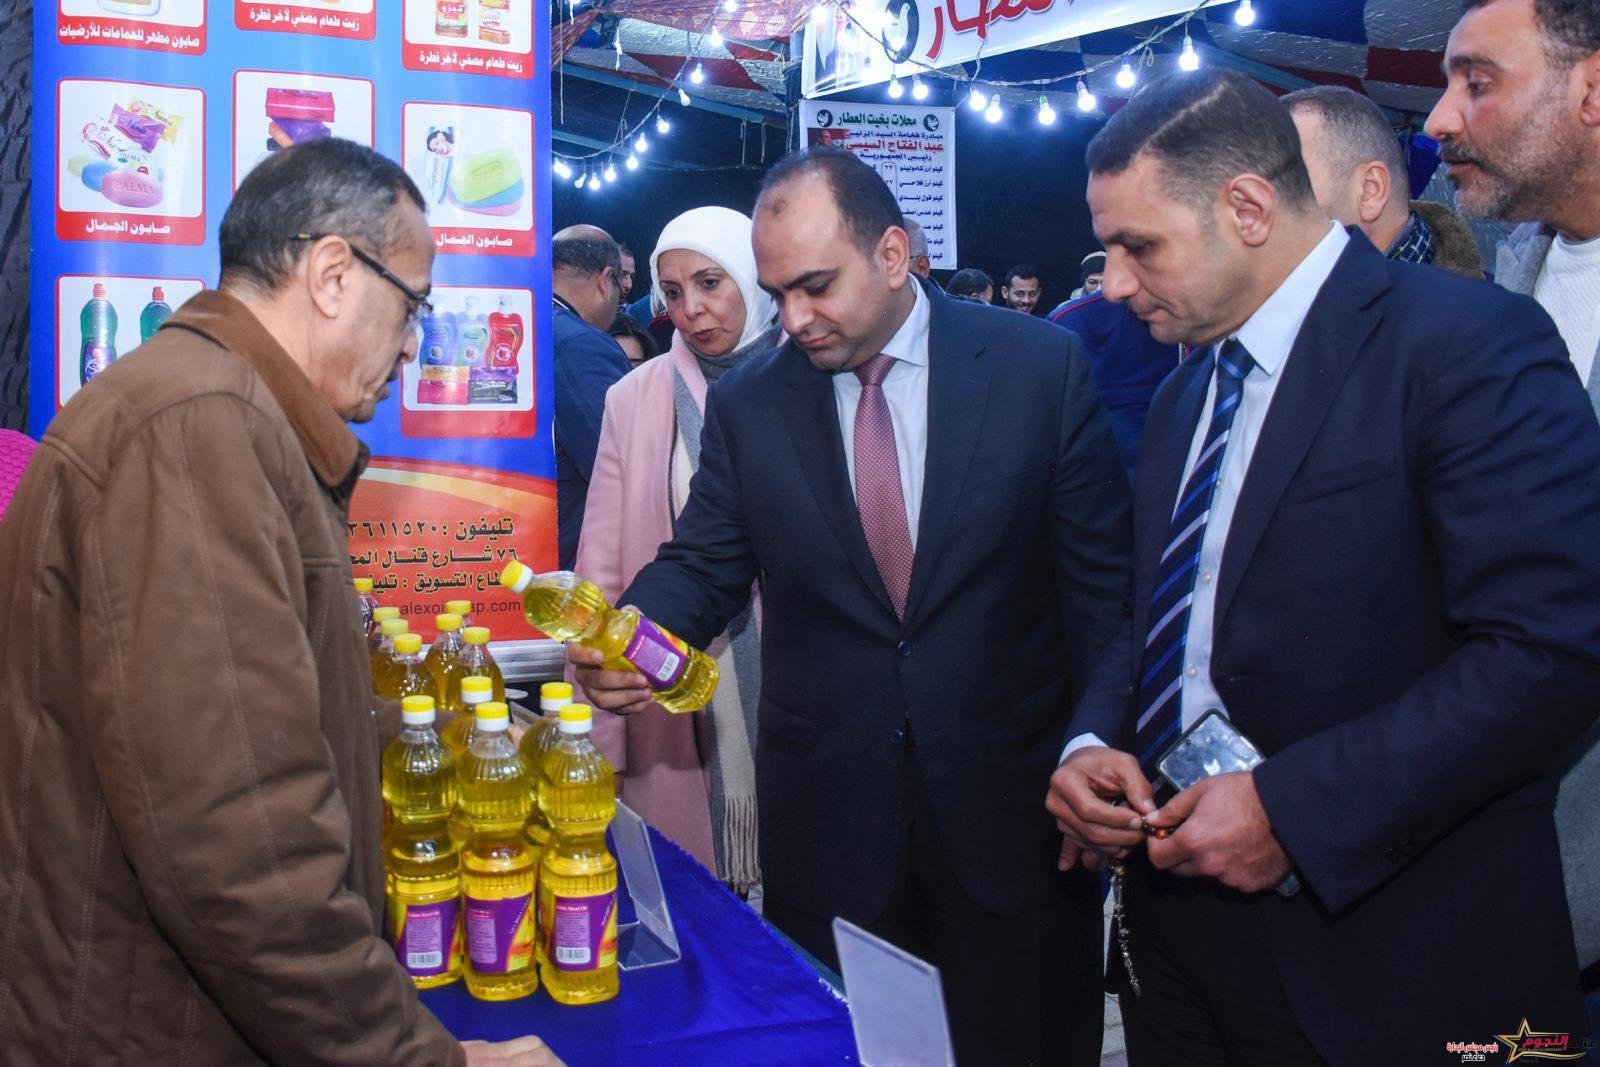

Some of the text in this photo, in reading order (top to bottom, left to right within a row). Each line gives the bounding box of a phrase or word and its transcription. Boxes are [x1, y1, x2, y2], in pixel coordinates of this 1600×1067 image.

[250, 8, 271, 23] قطرة
[320, 14, 340, 28] طعام
[342, 18, 360, 31] زيت
[102, 25, 144, 41] للحمامات
[145, 31, 170, 45] مطهر
[172, 34, 200, 48] صابون
[419, 51, 440, 64] قطرة
[485, 57, 505, 70] طعام
[507, 61, 523, 73] زيت
[837, 112, 917, 128] محلات بخيت العطار
[846, 130, 873, 139] الرئيس
[875, 131, 896, 139] السيد
[921, 131, 943, 140] مبادرة
[845, 140, 944, 155] عبد الفتاح السيسي
[860, 151, 932, 161] رئيس الجمهورية
[86, 218, 171, 235] صابون الجمال
[436, 233, 513, 248] صابون الجمال
[456, 518, 514, 541] تليفون
[381, 547, 429, 568] قنال
[432, 545, 493, 567] شارع
[414, 572, 473, 594] التسويق
